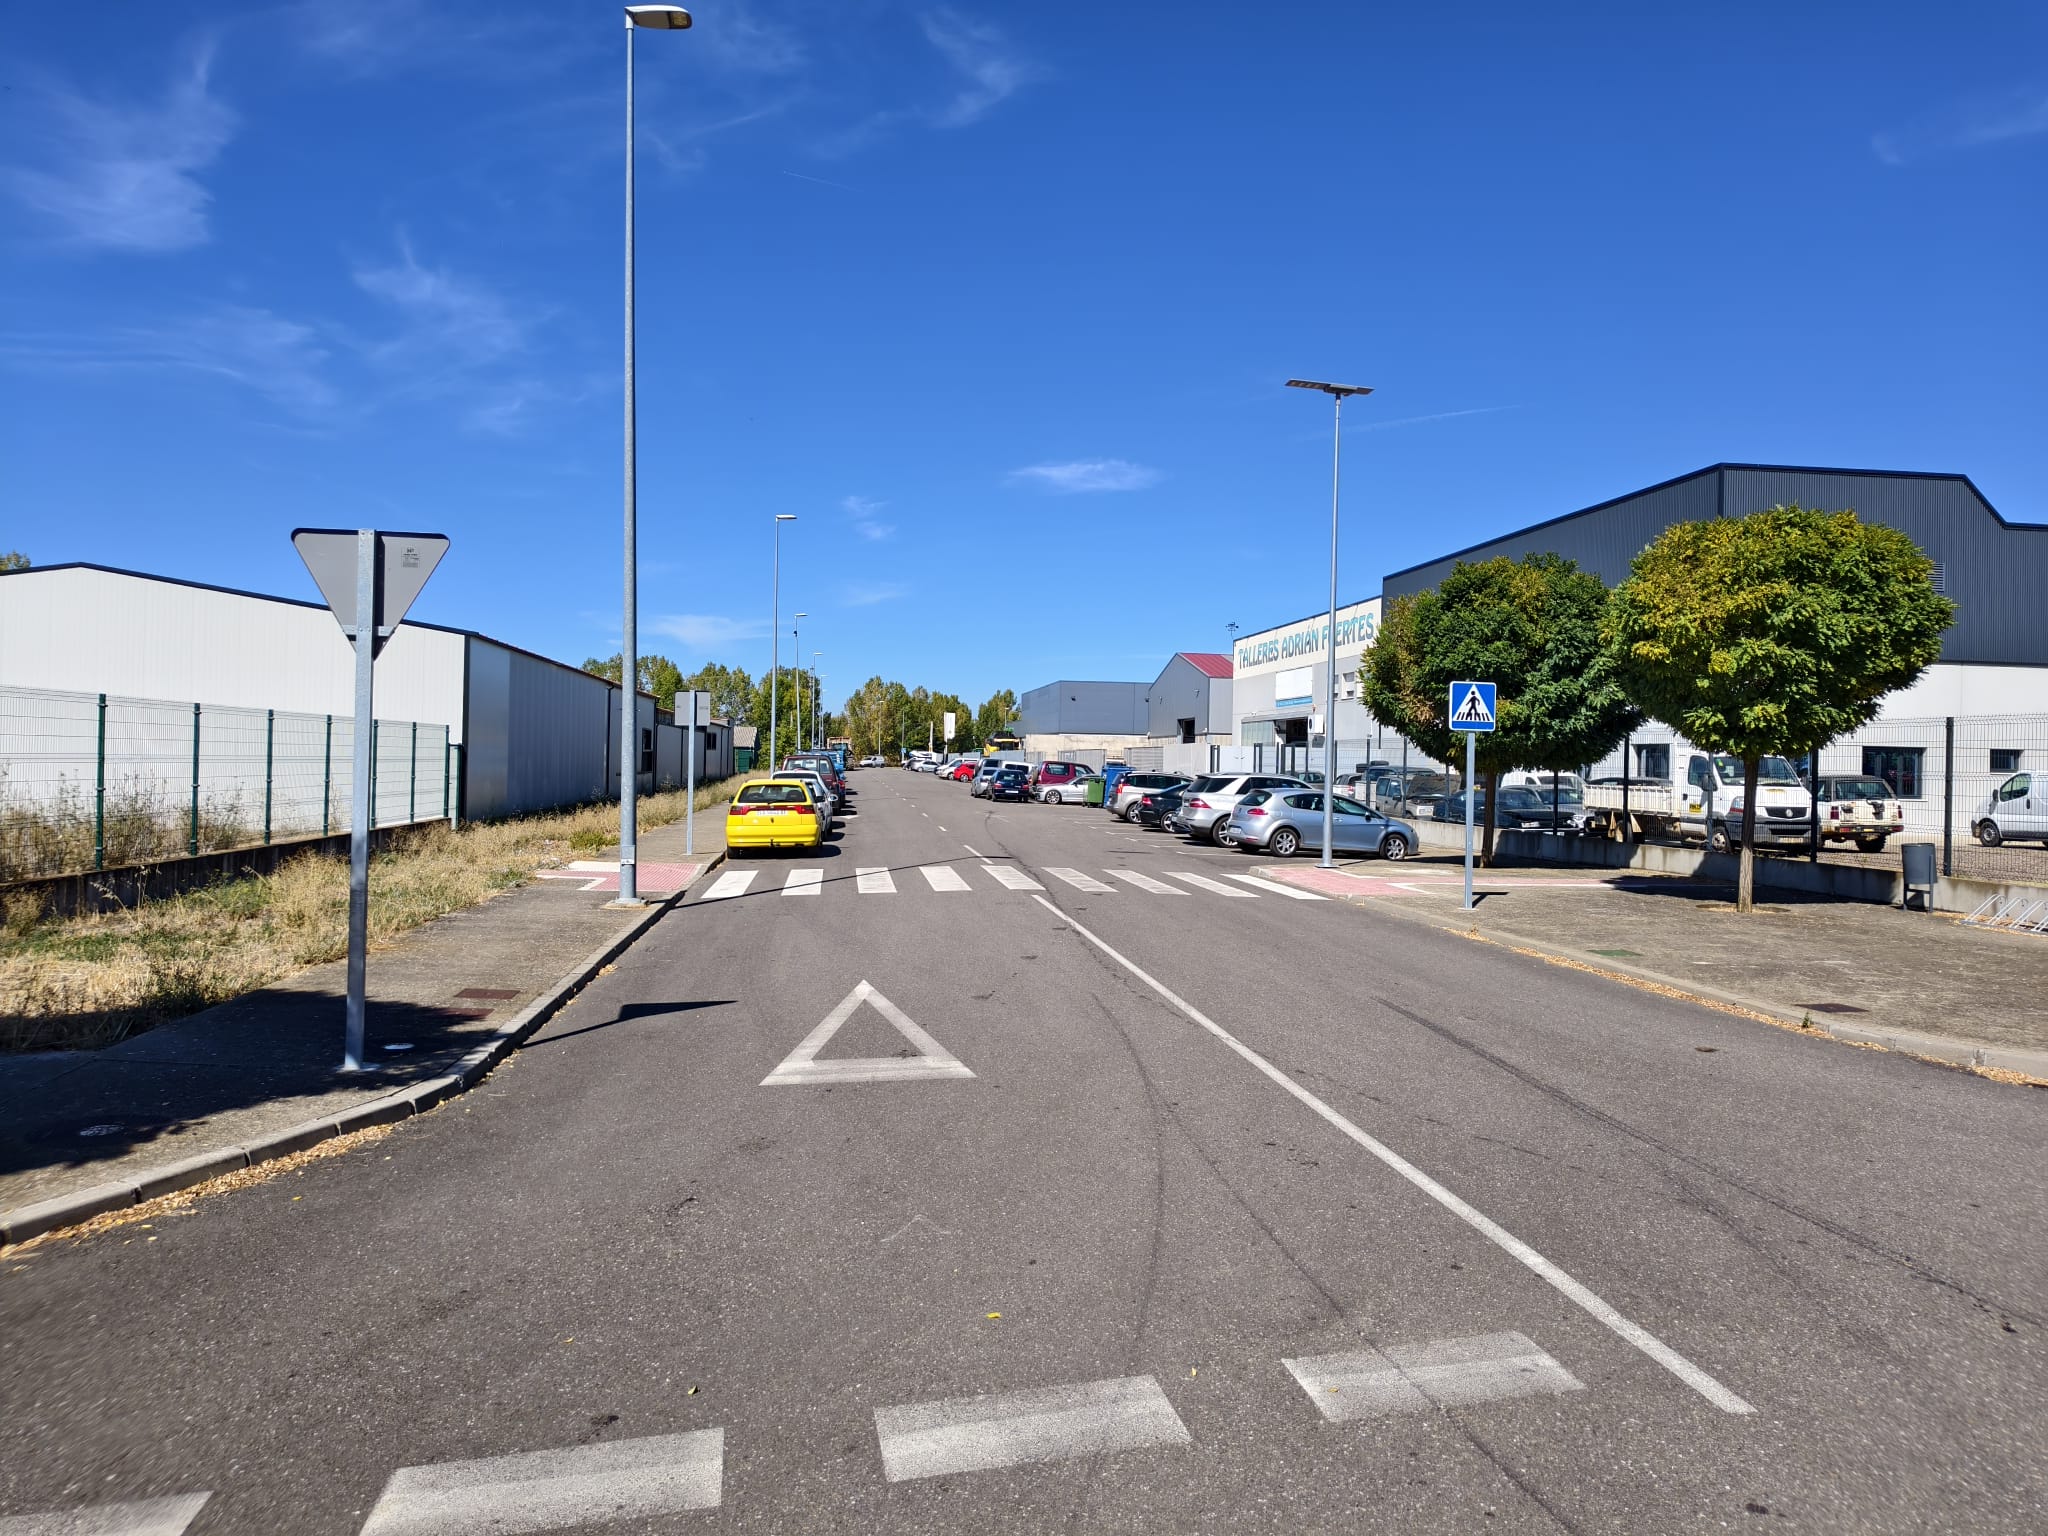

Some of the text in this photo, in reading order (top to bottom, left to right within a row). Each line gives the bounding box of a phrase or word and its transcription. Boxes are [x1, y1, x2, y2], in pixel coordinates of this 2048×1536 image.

[1238, 613, 1374, 669] TALLERES ADRIÁN FERTES
